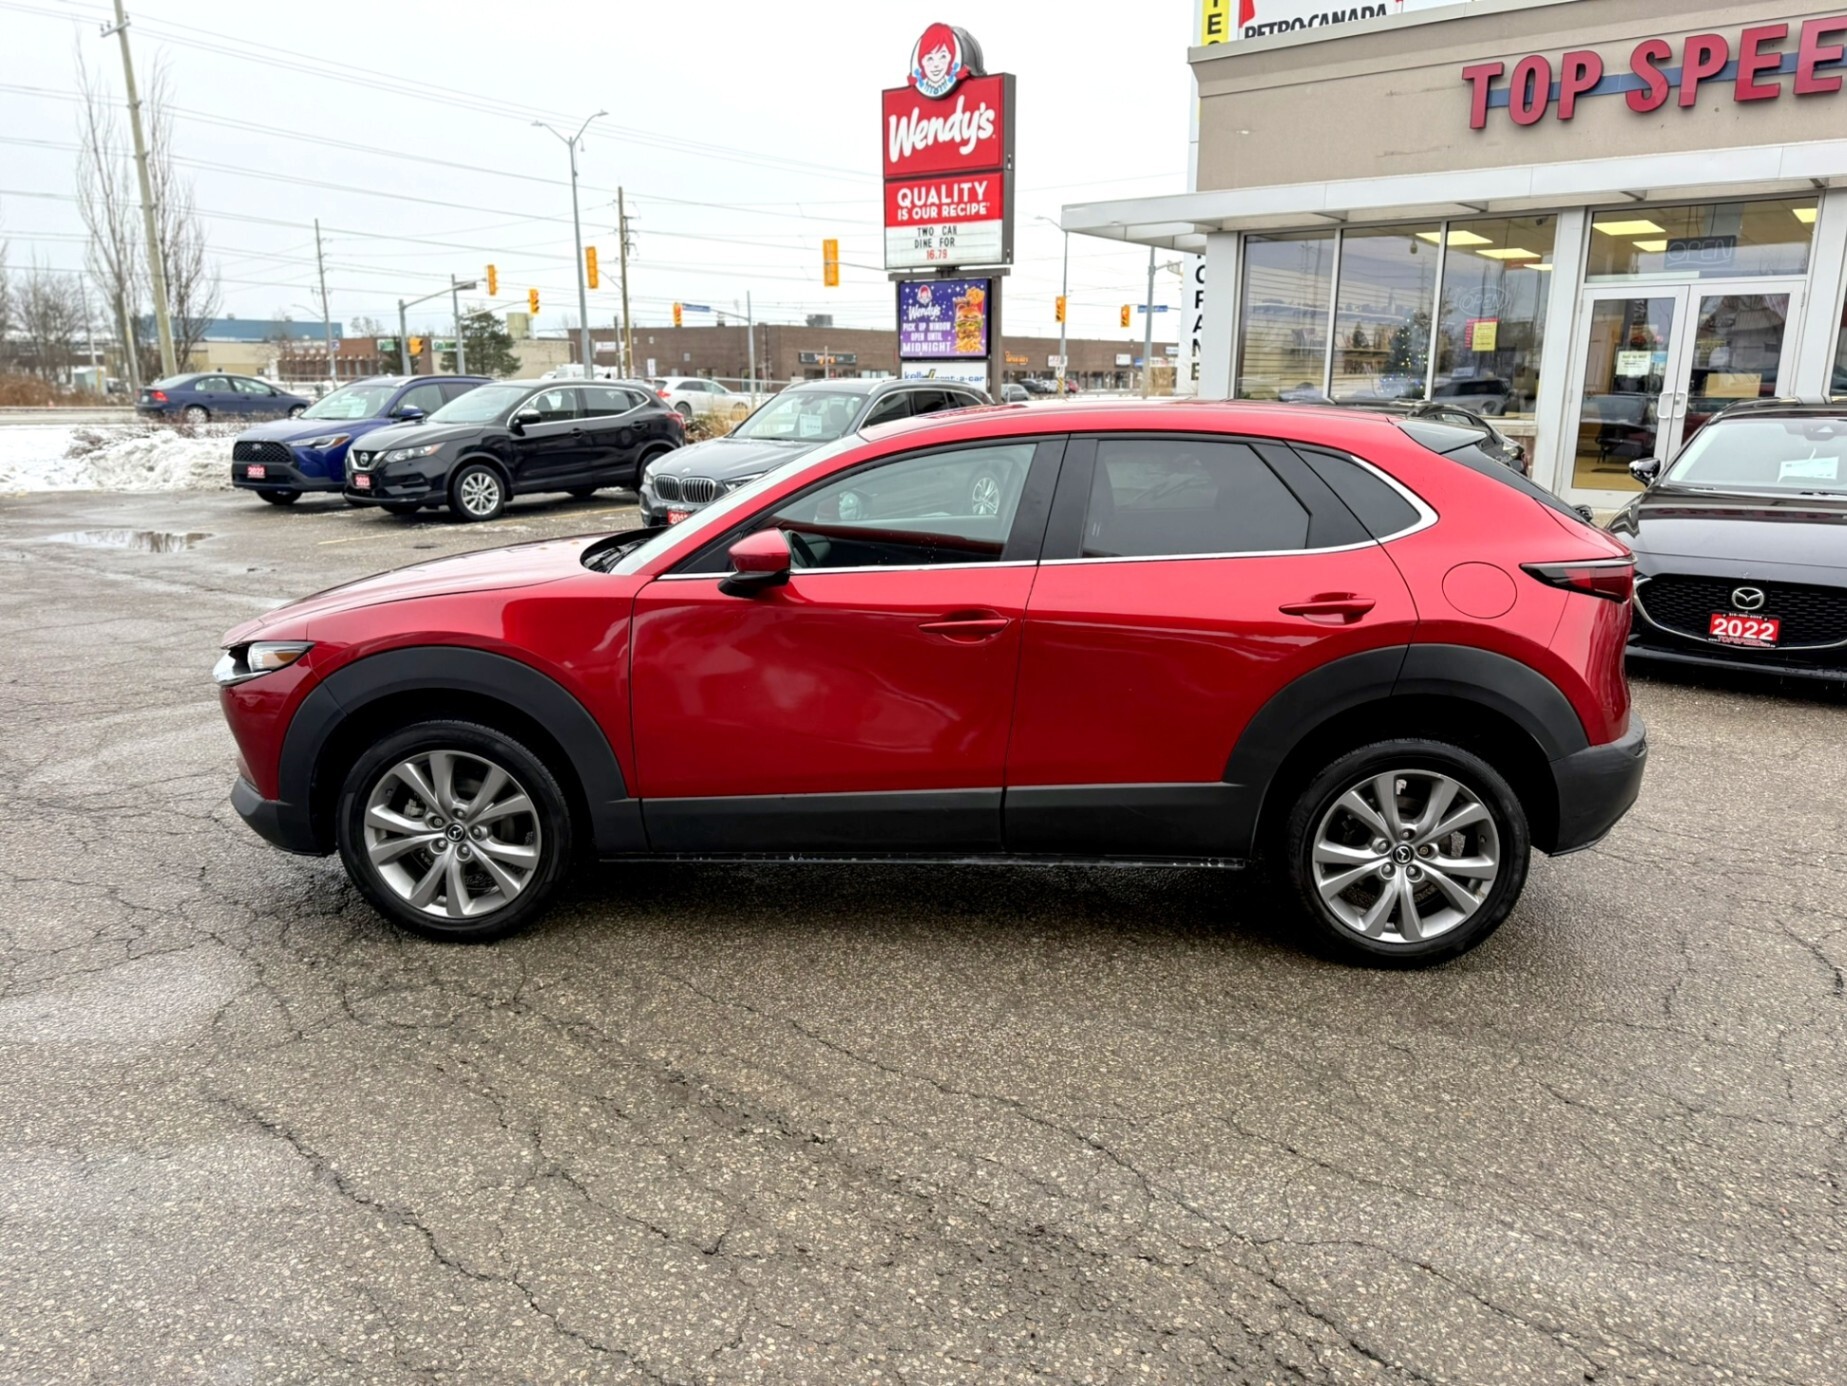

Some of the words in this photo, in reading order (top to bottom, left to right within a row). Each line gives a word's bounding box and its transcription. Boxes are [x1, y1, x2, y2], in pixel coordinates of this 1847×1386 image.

[1462, 50, 1604, 129] TOP
[889, 95, 995, 163] Wendy's
[897, 180, 988, 208] QUALITY
[897, 208, 909, 221] IS
[912, 206, 938, 219] OUR
[942, 202, 988, 217] RECIPE
[917, 227, 934, 237] TWO
[914, 238, 932, 249] DINE
[939, 237, 955, 247] FOR
[1667, 238, 1734, 261] OPEN
[908, 302, 941, 321] Wendy's
[918, 322, 927, 331] UP
[910, 332, 925, 341] OPEN
[902, 342, 951, 352] MIDNIGHT
[1712, 618, 1775, 640] 2022
